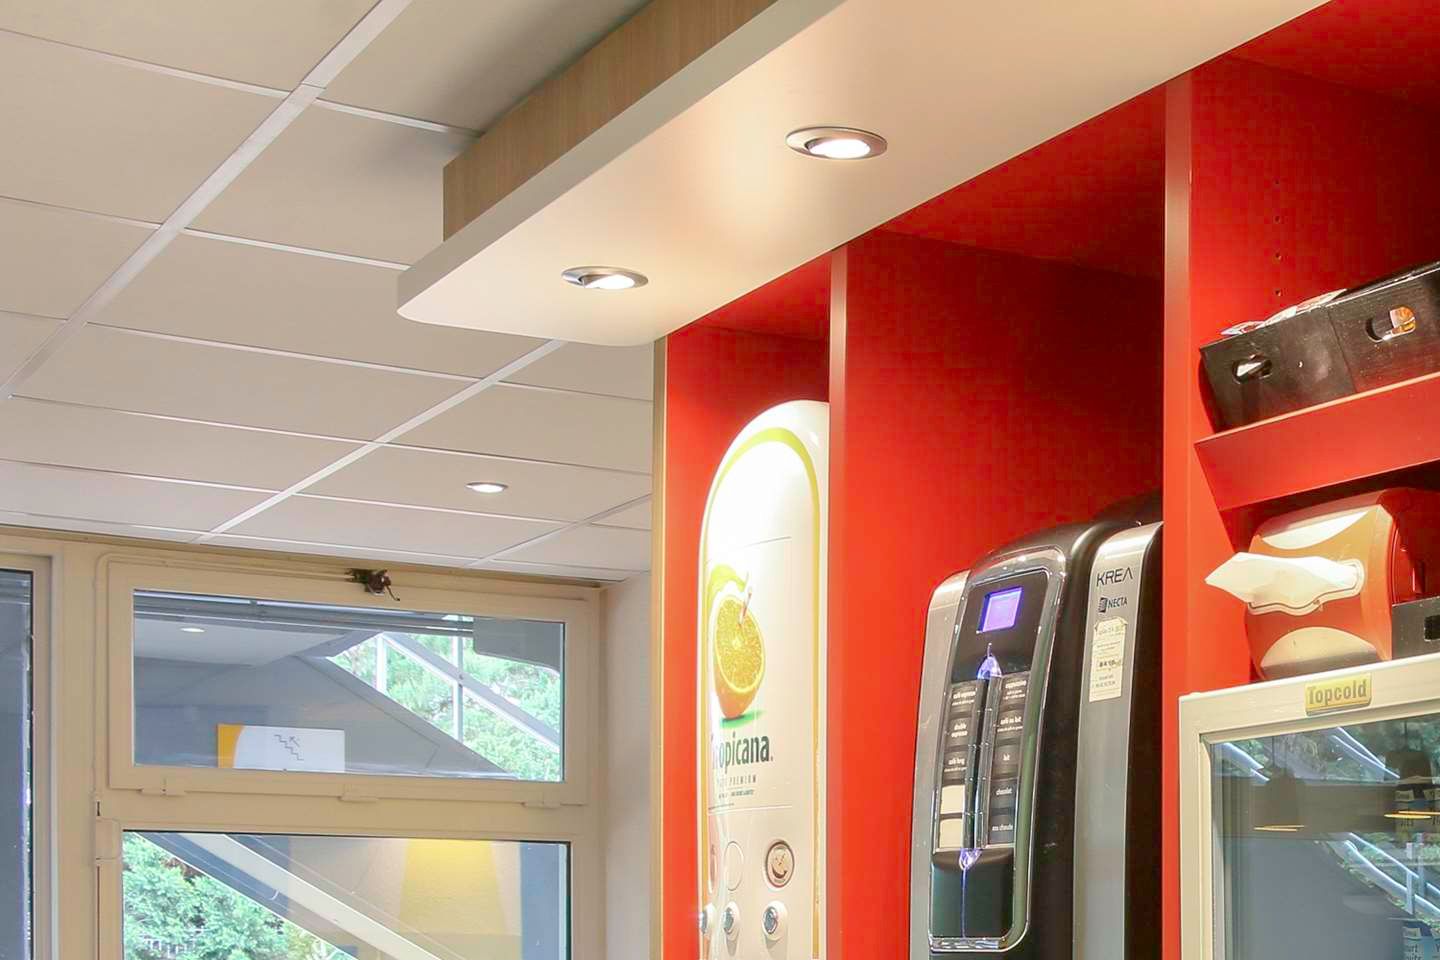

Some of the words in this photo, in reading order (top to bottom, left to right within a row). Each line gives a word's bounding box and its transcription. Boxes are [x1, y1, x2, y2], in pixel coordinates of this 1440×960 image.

[1107, 597, 1128, 609] NECTA
[1306, 679, 1368, 706] Topcold
[711, 731, 770, 775] opicana
